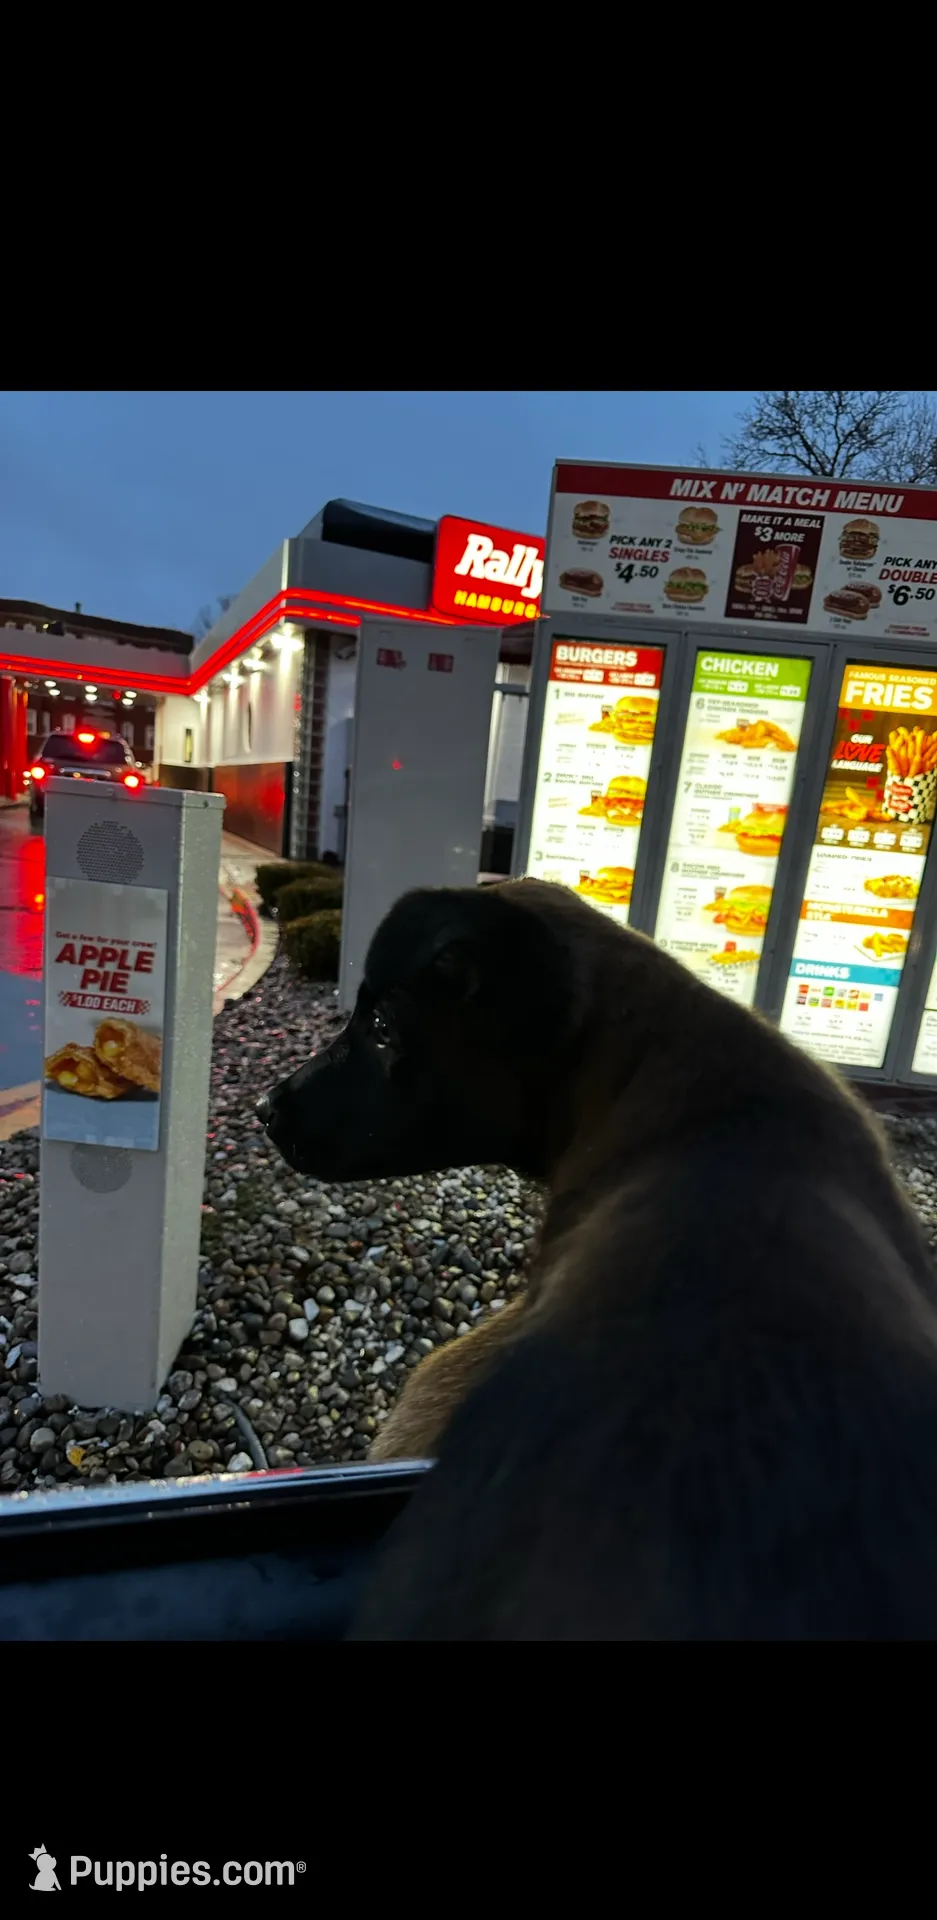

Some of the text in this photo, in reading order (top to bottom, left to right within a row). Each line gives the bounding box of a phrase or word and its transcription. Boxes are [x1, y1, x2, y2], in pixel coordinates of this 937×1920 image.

[669, 478, 717, 499] MIX
[747, 483, 829, 507] MATCH
[833, 491, 904, 513] MENU
[741, 514, 821, 528] MAKE IT A MEAL
[609, 535, 637, 546] PICK
[639, 537, 663, 548] ANY
[664, 539, 673, 548] 2
[754, 526, 805, 543] $3 MORE
[608, 547, 670, 563] SINGLES
[884, 556, 913, 568] PICK
[914, 559, 937, 570] ANY
[615, 563, 659, 584] $4.50
[887, 584, 936, 606] $6.50
[454, 590, 541, 619] HAMBURG
[556, 645, 638, 667] BURGERS
[700, 656, 779, 678] CHICKEN
[848, 671, 887, 681] FAMOUS
[844, 680, 934, 711] FRIES
[850, 733, 874, 745] OUR
[832, 741, 886, 763] LOVE
[831, 759, 884, 773] LANGUAGE
[543, 772, 552, 783] 2
[684, 781, 692, 793] 7
[96, 935, 110, 943] for
[110, 938, 131, 947] your
[55, 942, 155, 973] APPLE
[795, 962, 850, 979] DRINKS
[80, 968, 130, 994] PIE
[72, 994, 136, 1012] $1.00 EACH
